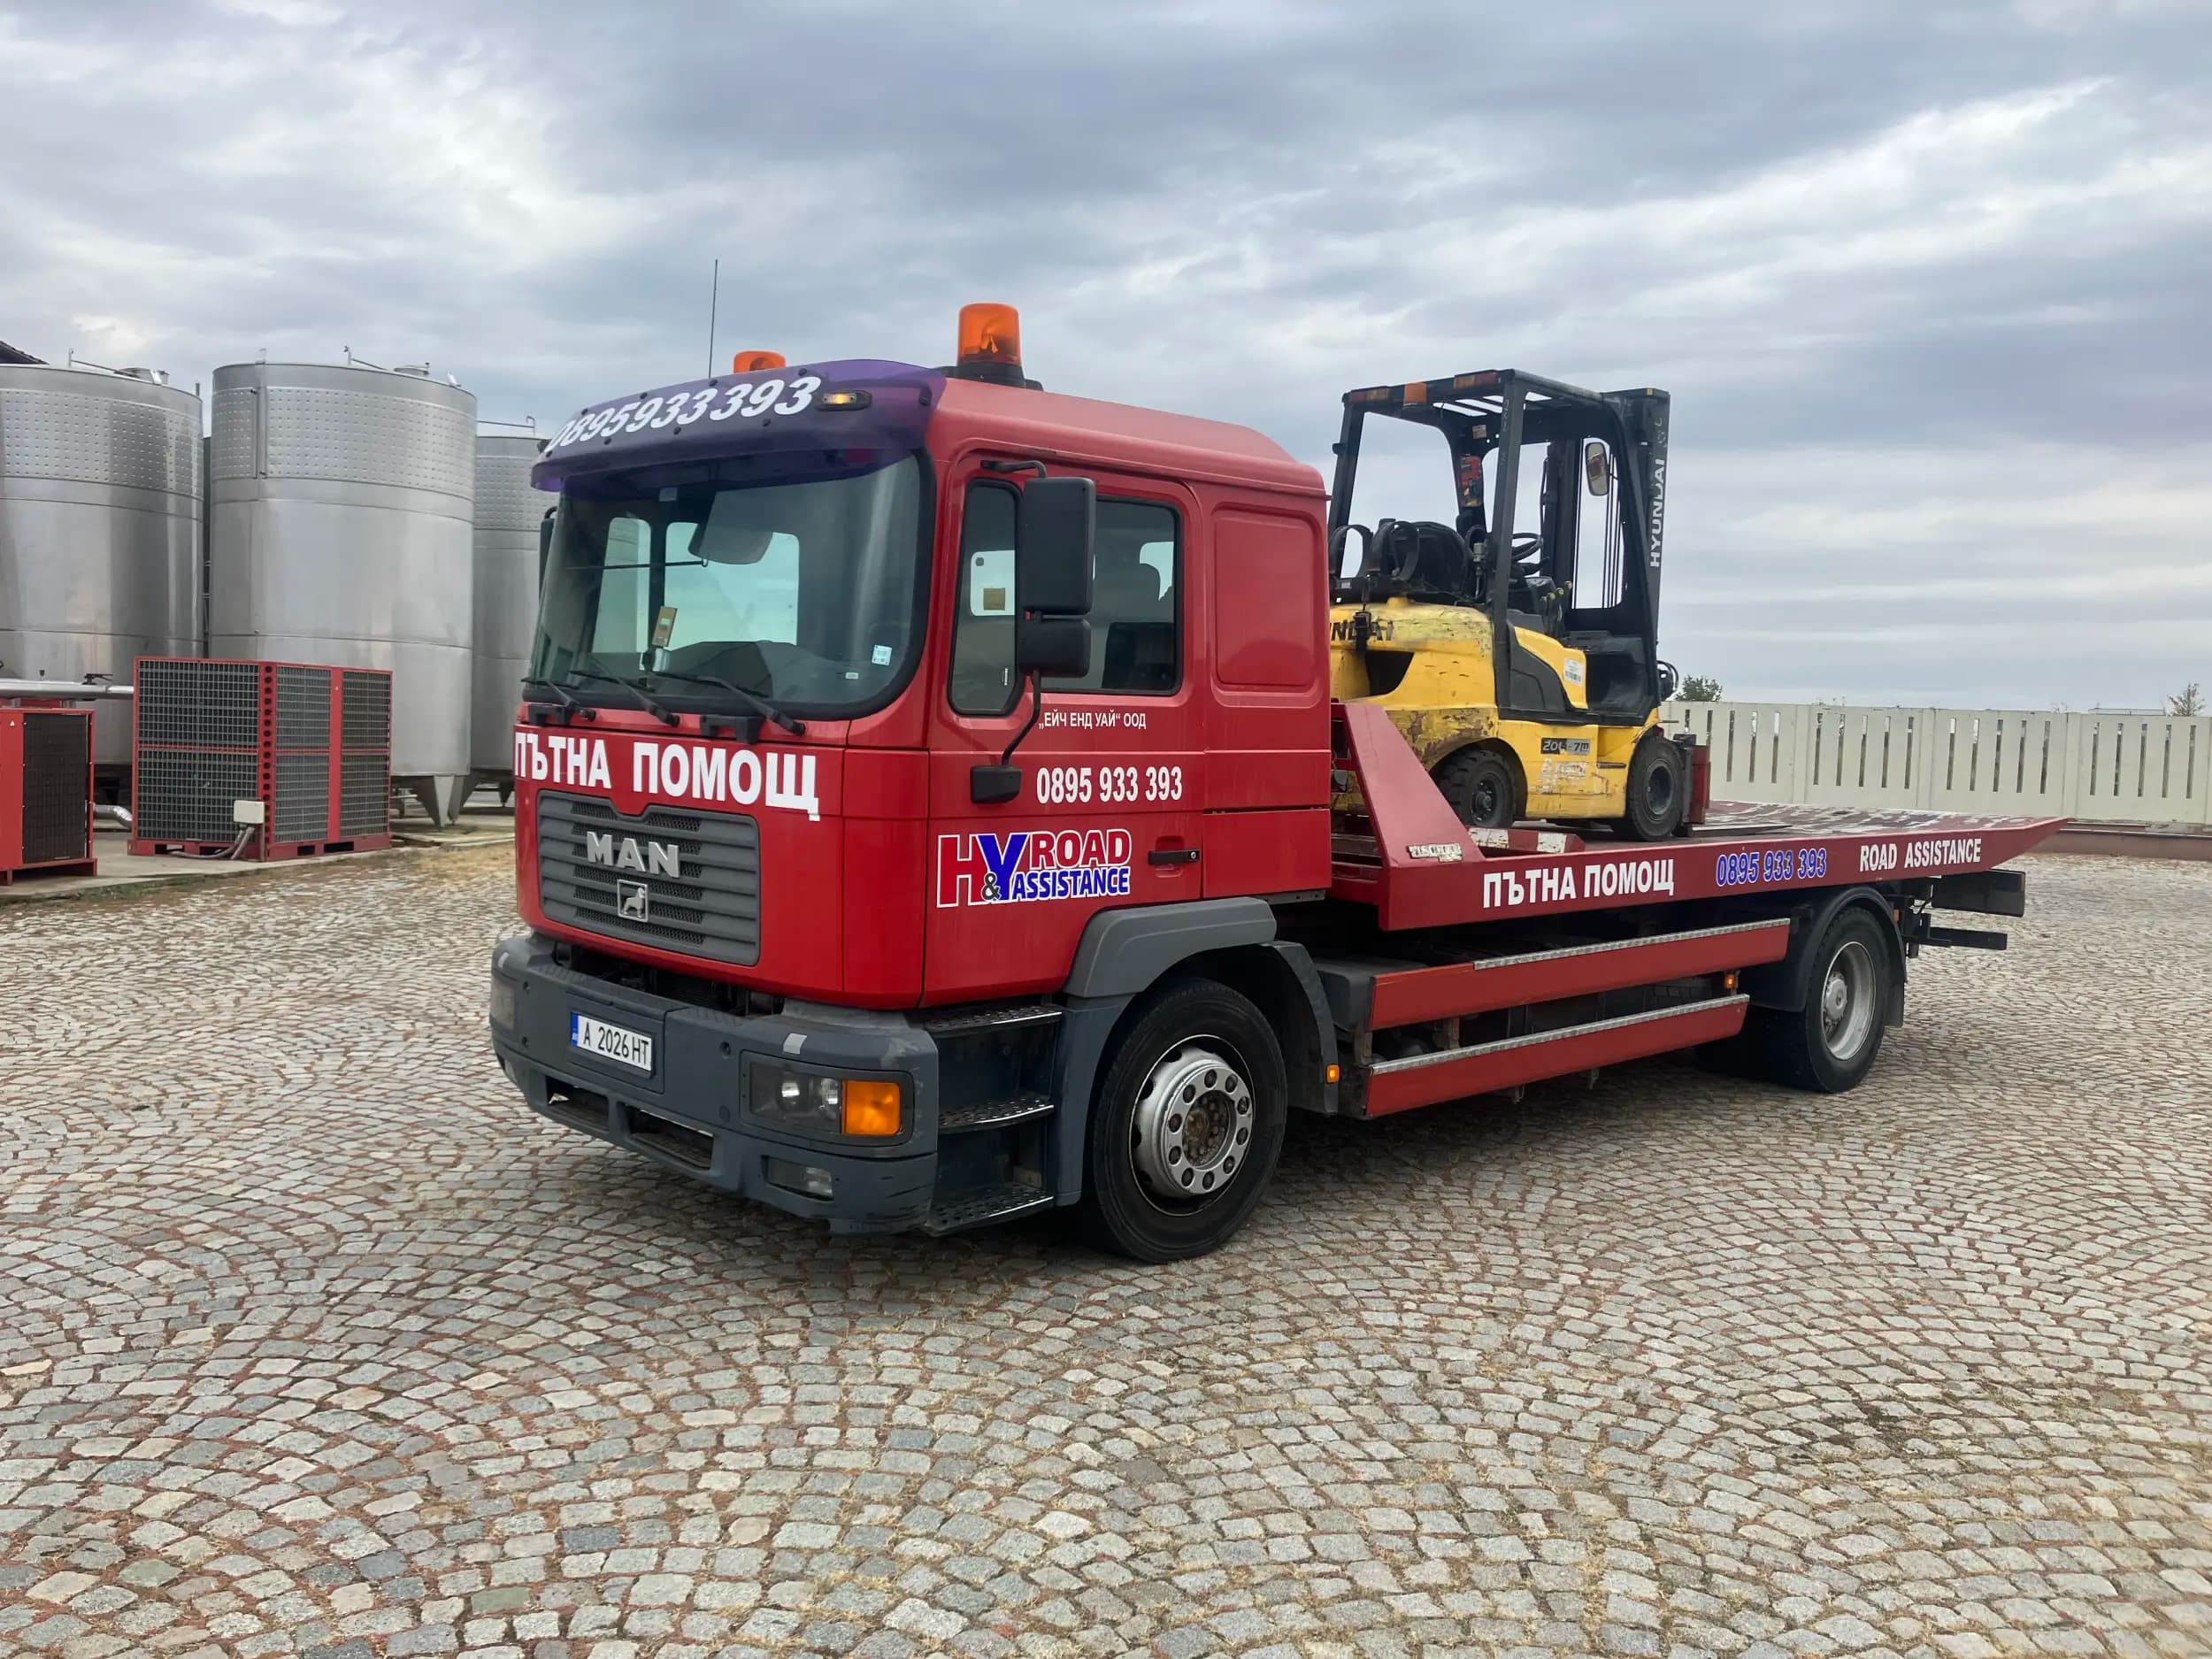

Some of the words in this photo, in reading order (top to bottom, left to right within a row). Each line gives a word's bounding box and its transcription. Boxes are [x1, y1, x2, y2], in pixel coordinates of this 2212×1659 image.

[1650, 458, 1665, 568] HYUNDAI
[1070, 712, 1093, 730] ЕНД
[1123, 712, 1147, 730] ООД
[514, 732, 612, 789] ПЪТНА
[633, 741, 821, 822] ПОМОЩ
[1036, 767, 1092, 804] 0895
[1099, 766, 1139, 802] 933
[1145, 765, 1183, 801] 393
[587, 831, 680, 879] MAN
[1028, 828, 1132, 870] ROAD
[1717, 852, 1760, 887] 0895
[1763, 849, 1793, 882] 933
[1797, 848, 1827, 879] 393
[1860, 843, 1898, 872] ROAD
[1904, 838, 1982, 869] ASSISTANCE
[1011, 866, 1131, 901] ASSISTANCE
[1483, 867, 1578, 909] ПЪТНА
[1583, 858, 1674, 898] ПОМОЩ
[597, 1026, 629, 1057] 2026
